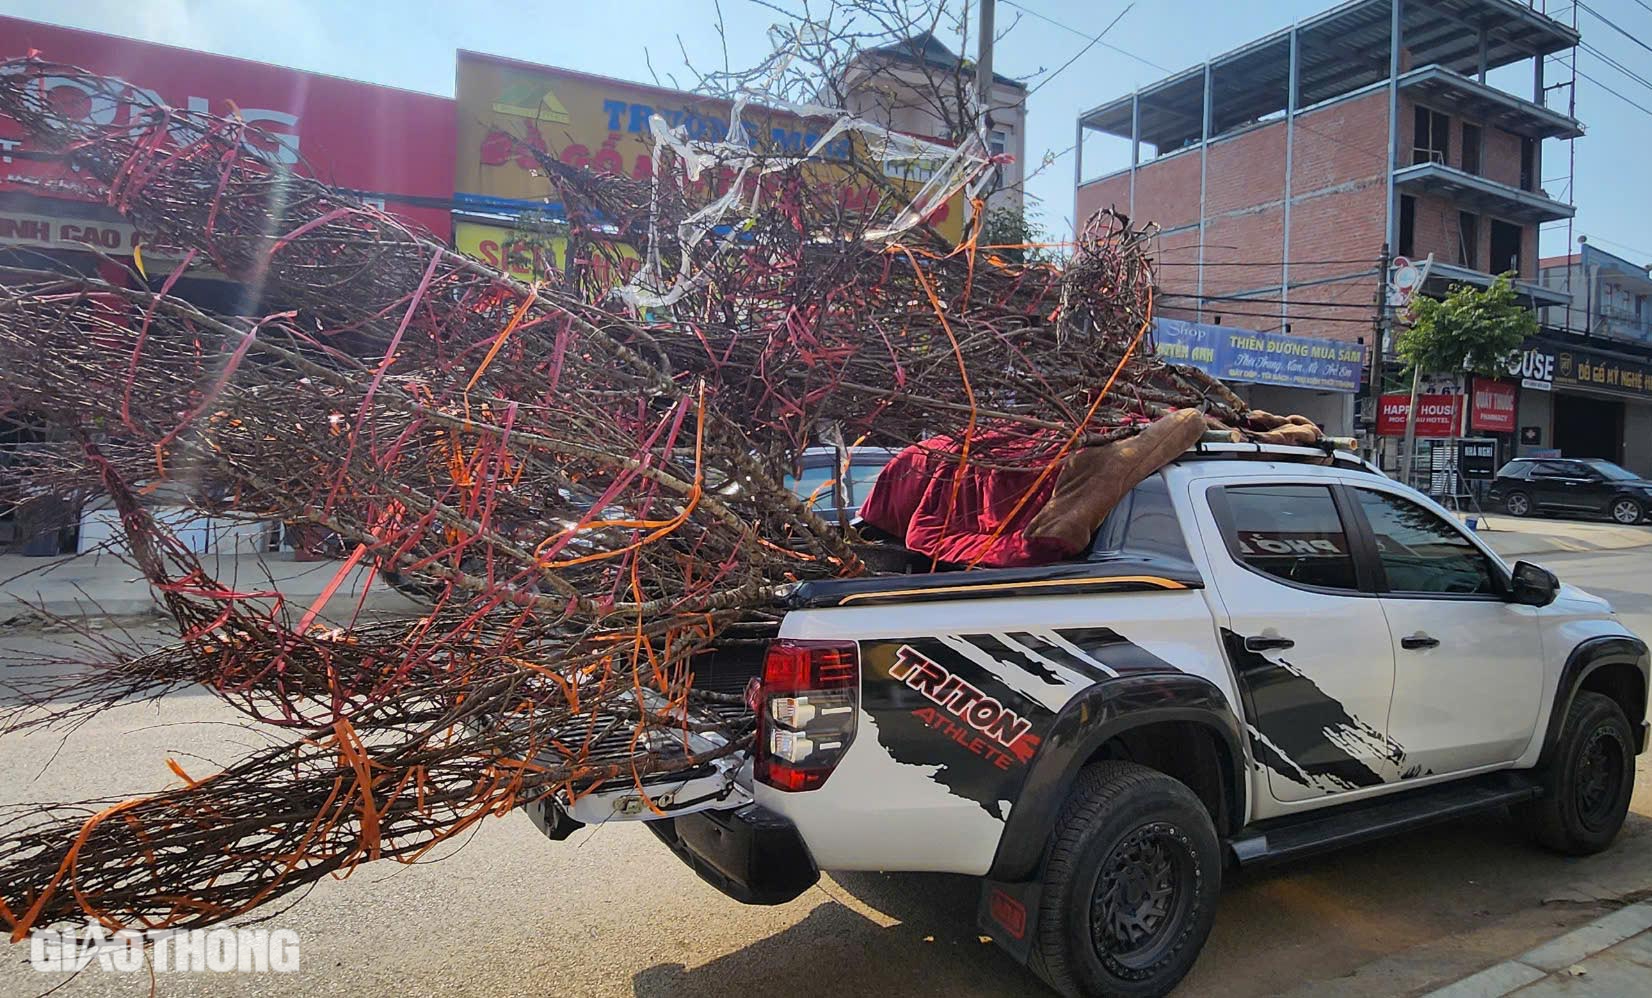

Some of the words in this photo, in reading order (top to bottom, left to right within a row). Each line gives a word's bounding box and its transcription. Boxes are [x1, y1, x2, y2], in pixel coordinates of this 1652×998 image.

[1167, 324, 1206, 341] Shop
[1230, 335, 1265, 351] THIÊN
[1311, 346, 1336, 360] MUA
[1383, 404, 1412, 415] HAPP
[889, 645, 1032, 747] TRITON
[912, 707, 1013, 770] ATHLETE
